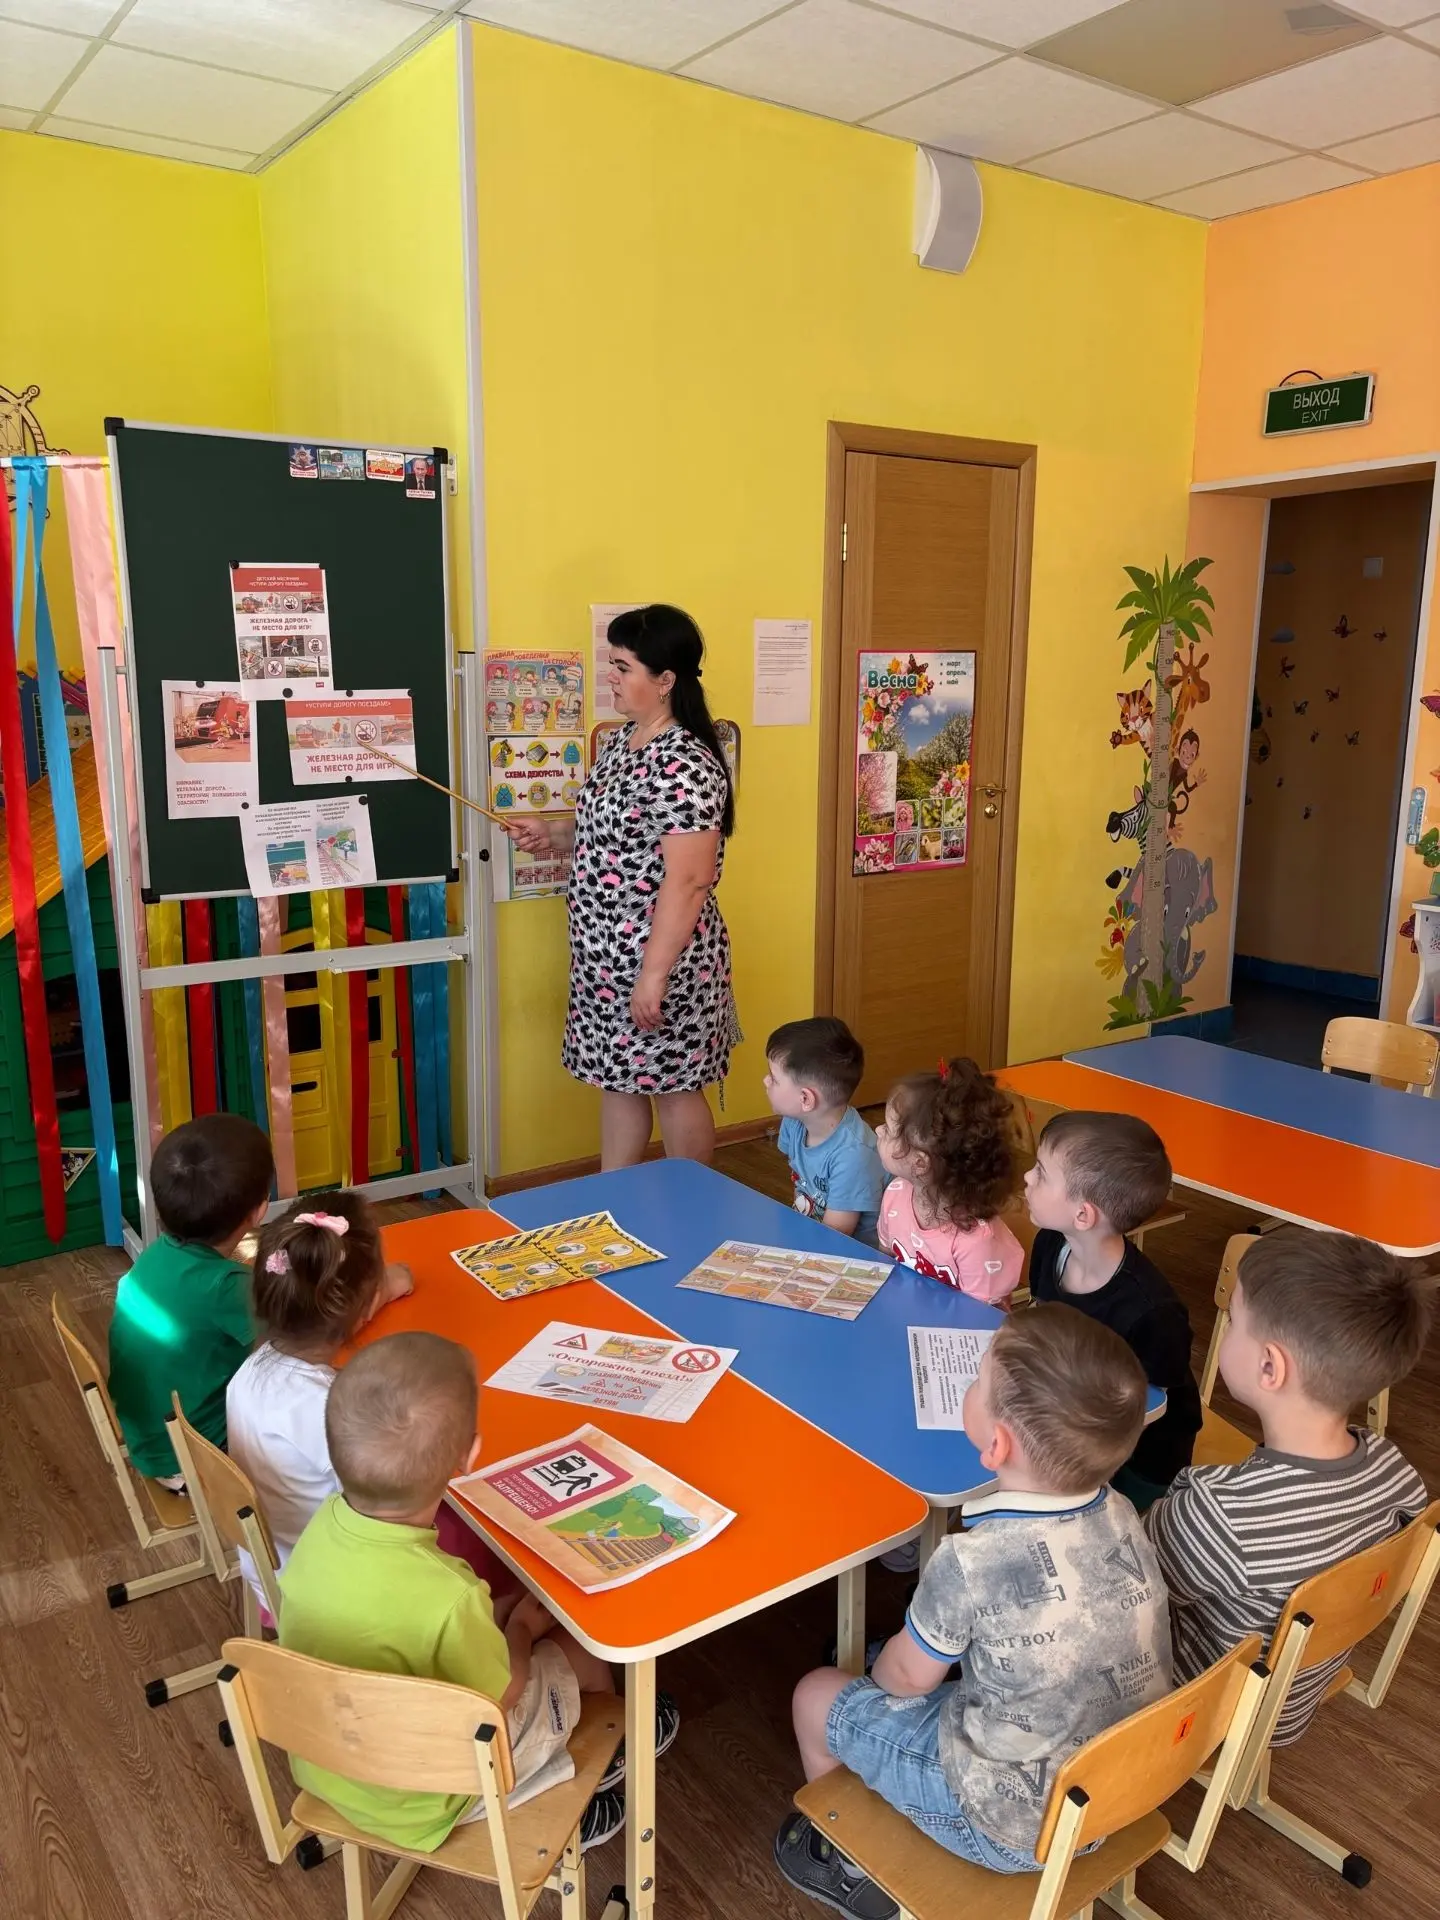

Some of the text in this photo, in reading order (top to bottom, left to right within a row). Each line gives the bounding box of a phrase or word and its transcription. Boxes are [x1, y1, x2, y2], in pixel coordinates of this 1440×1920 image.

[1293, 387, 1340, 409] ВЫХОД
[1302, 409, 1330, 424] EXIT
[868, 670, 917, 688] Весна
[307, 753, 354, 763] ЖЕЛЕЗНАЯ
[310, 765, 322, 773] НЕ
[324, 764, 354, 773] МЕСТО
[356, 763, 374, 773] ДЛЯ
[505, 769, 564, 779] СХЕМА ДЕЖУРСТВА
[548, 1352, 636, 1374] «Осторожно,
[492, 1480, 539, 1514] ЗАПРЕЩЕНО!
[1120, 1587, 1153, 1610] CORE
[1022, 1630, 1056, 1648] BOY
[1119, 1651, 1152, 1674] NINE
[998, 1711, 1030, 1723] SPORT
[995, 1782, 1043, 1809] CORE
